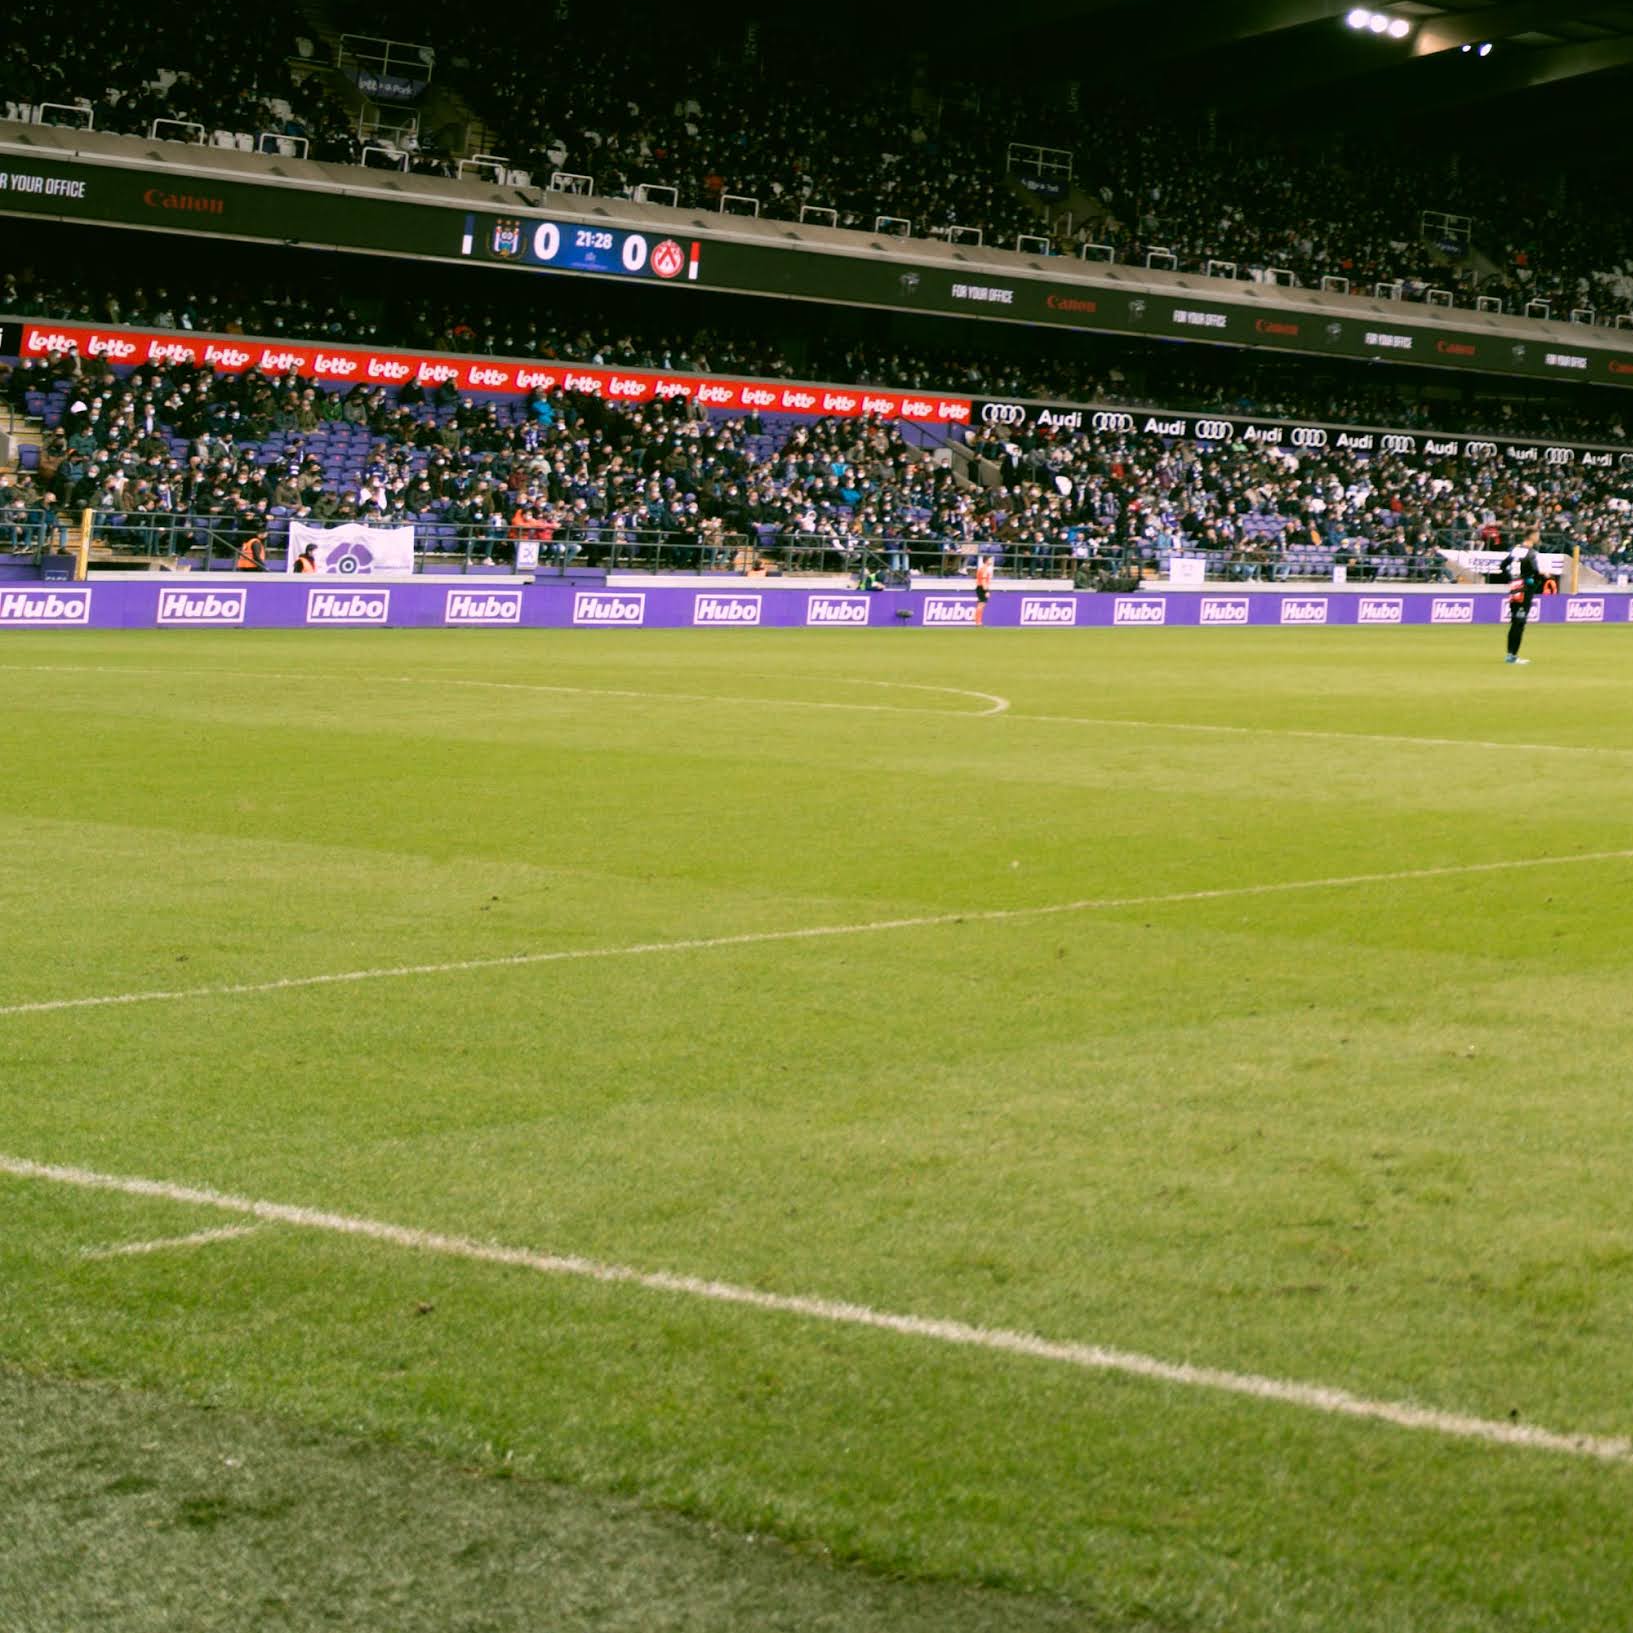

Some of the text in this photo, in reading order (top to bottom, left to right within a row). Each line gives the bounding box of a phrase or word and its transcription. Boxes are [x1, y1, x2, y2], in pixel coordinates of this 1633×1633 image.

[11, 174, 43, 193] YOUR
[46, 178, 86, 198] OFFICE
[144, 189, 224, 212] Canon
[534, 223, 648, 271] 0 21:28 0
[952, 284, 1013, 303] FOR YOUR OFFICE
[1046, 295, 1097, 313] Canon
[1038, 410, 1081, 429] Audi
[1144, 418, 1185, 435] Audi
[1244, 426, 1282, 444] Audi
[1337, 434, 1372, 448] Audi
[1425, 440, 1457, 455] Audi
[2, 594, 85, 618] Hubo
[162, 594, 240, 619] Hubo
[311, 594, 384, 618] Hubo
[449, 595, 516, 619] Hubo
[577, 597, 640, 620] Hubo
[698, 599, 757, 621] Hubo
[810, 600, 865, 621] Hubo
[929, 602, 976, 621] Hubo
[1023, 602, 1072, 622] Hubo
[1117, 602, 1162, 622] Hubo
[1203, 602, 1244, 622] Hubo
[1283, 602, 1323, 622] Hubo
[1360, 602, 1400, 621] Hubo
[1433, 602, 1471, 620] Hubo
[1568, 602, 1601, 619] Hubo
